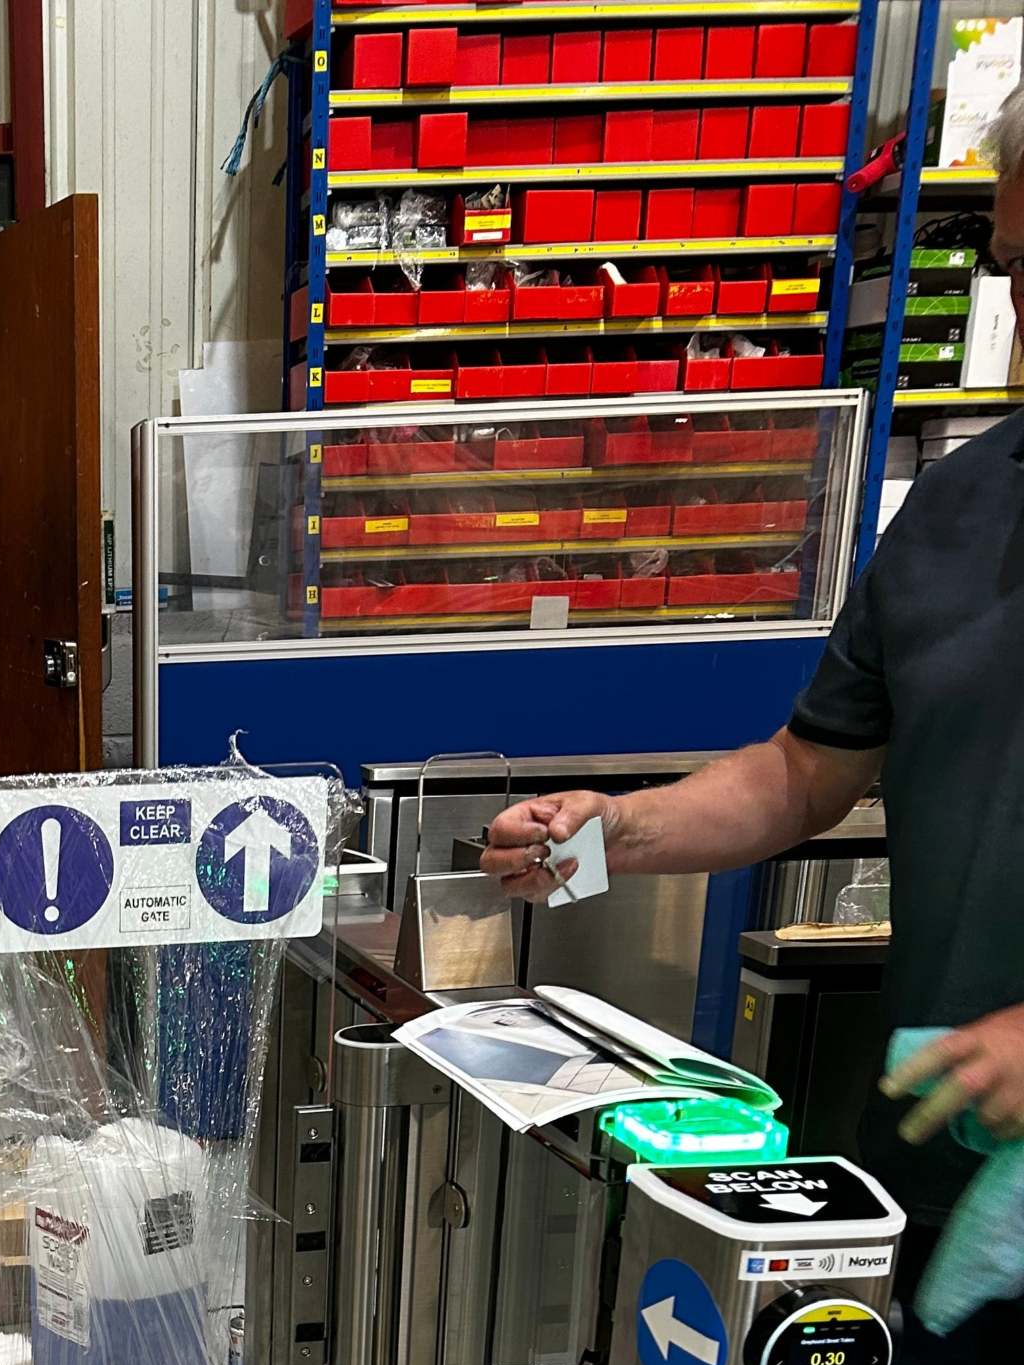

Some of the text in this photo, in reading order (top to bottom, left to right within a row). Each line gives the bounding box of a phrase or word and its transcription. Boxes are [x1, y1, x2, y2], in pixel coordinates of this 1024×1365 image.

[317, 56, 325, 67] O
[315, 153, 323, 163] N
[315, 219, 324, 229] M
[313, 308, 321, 318] L
[312, 372, 320, 382] K
[308, 590, 316, 599] H
[135, 805, 176, 821] KEEP
[130, 825, 181, 840] CLEAR
[124, 895, 187, 909] AUTOMATIC
[141, 911, 170, 923] GATE
[707, 1169, 803, 1182] SCAN
[704, 1179, 829, 1194] BELOW
[848, 1256, 888, 1268] Nayax
